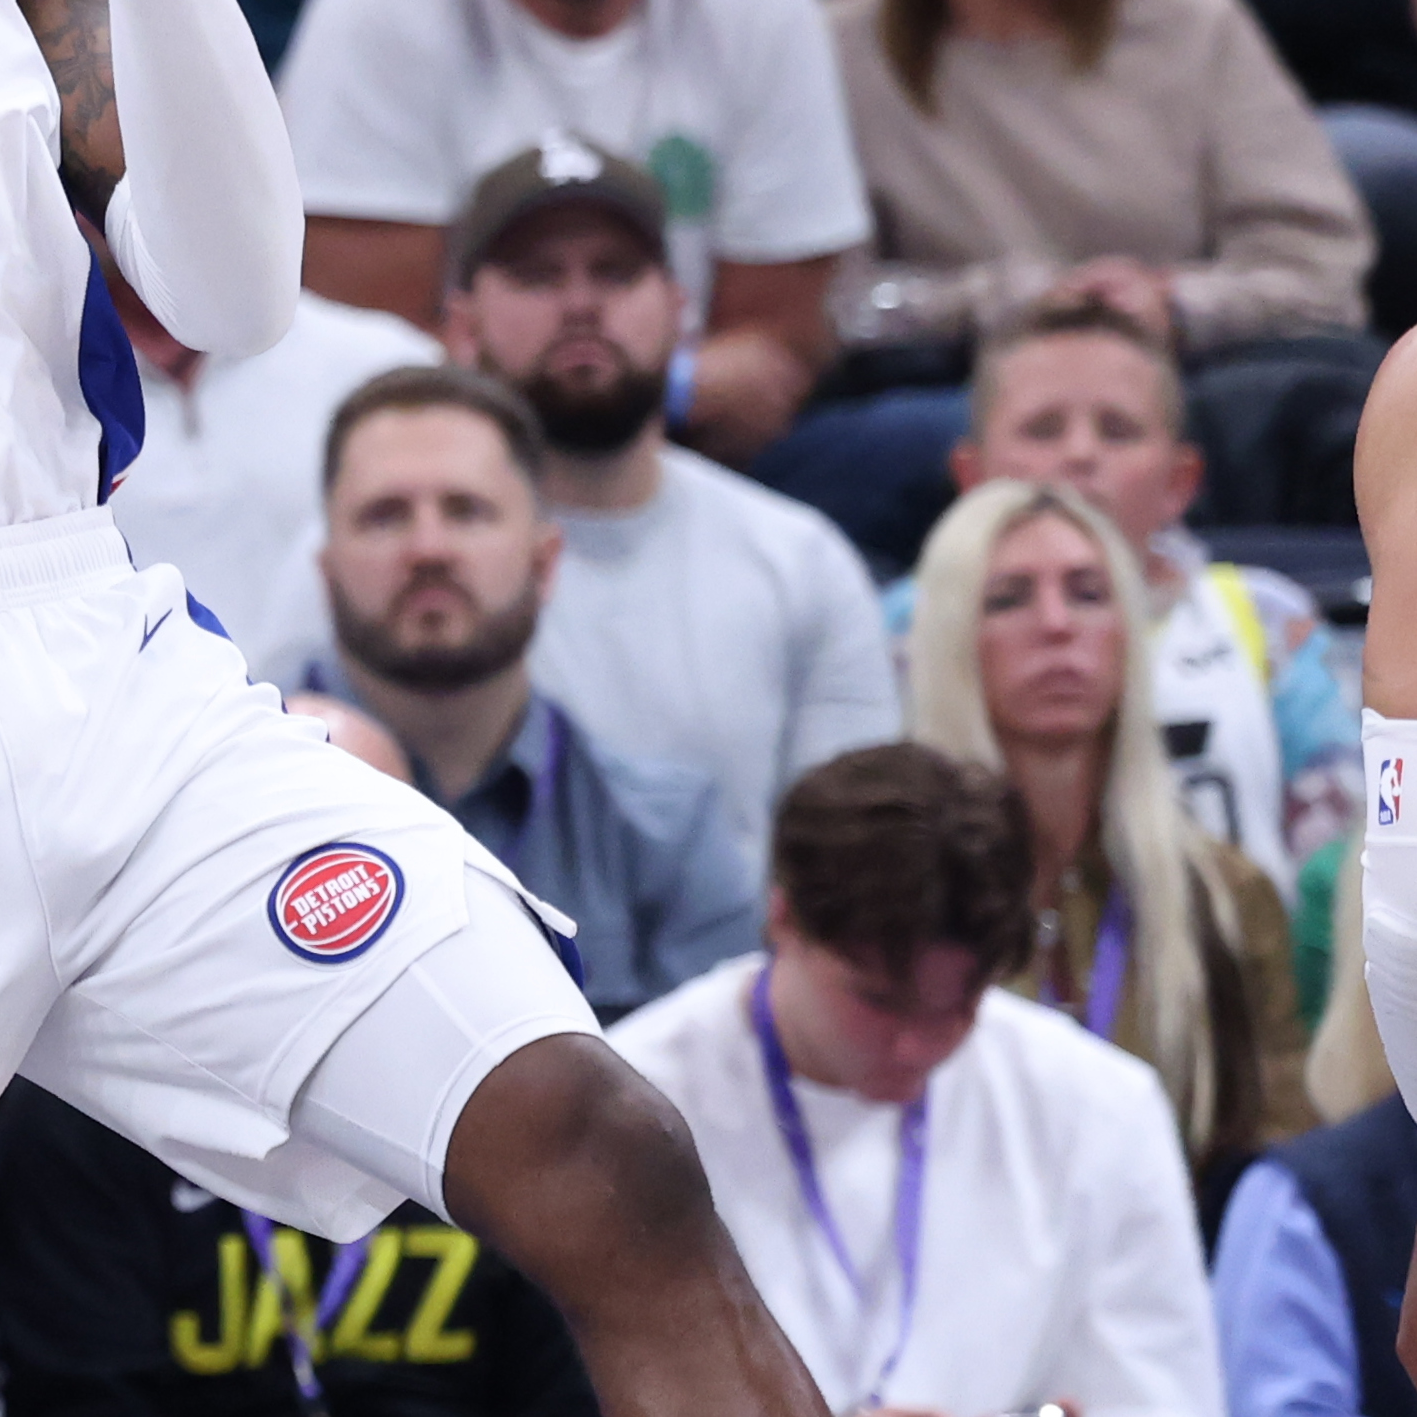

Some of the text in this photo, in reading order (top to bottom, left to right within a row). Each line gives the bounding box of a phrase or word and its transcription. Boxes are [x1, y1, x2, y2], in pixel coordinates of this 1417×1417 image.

[290, 864, 369, 917] DETROIT
[300, 878, 381, 935] PISTONS
[172, 1227, 478, 1373] JAZZ
